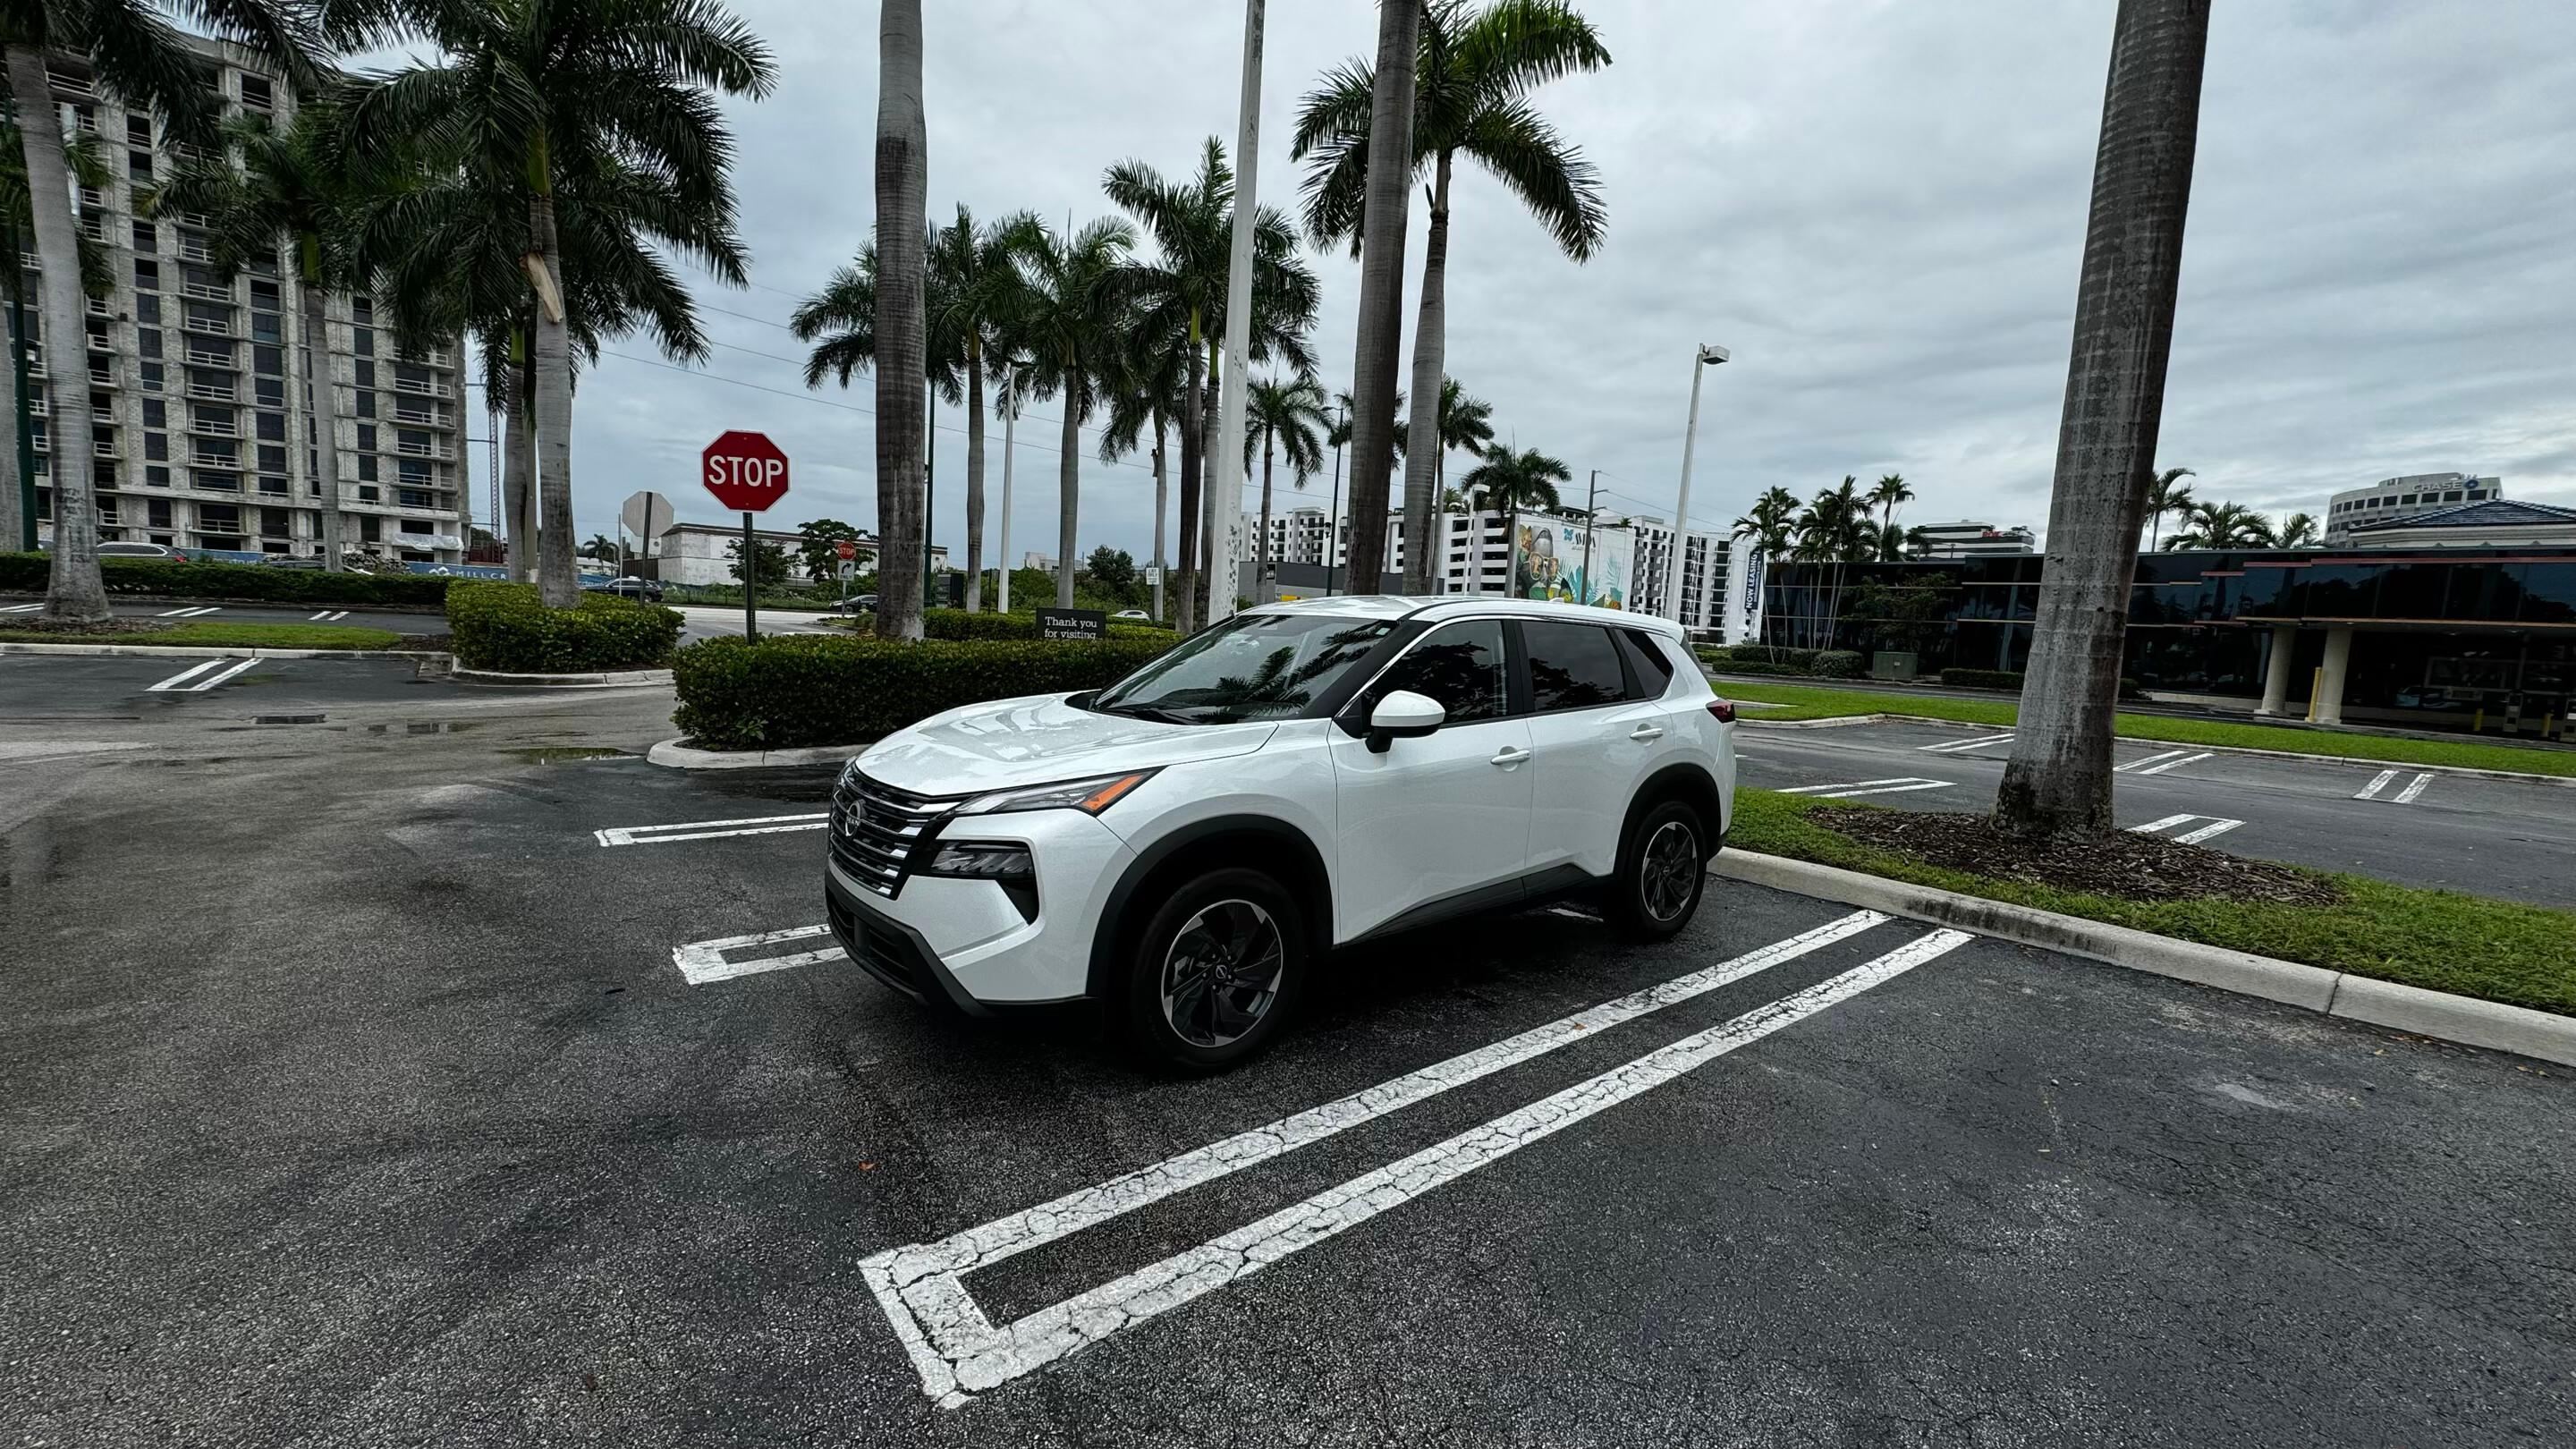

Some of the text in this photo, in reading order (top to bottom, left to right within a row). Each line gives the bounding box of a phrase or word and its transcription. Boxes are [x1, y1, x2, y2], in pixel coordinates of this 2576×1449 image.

[708, 454, 784, 487] STOP
[2411, 481, 2462, 492] CHASE
[838, 547, 855, 555] STOP
[456, 571, 507, 580] MILLCR
[1748, 554, 1758, 587] LEASING
[1745, 588, 1754, 608] NOW
[1045, 616, 1097, 629] Thank you
[1044, 628, 1097, 640] for visiting
